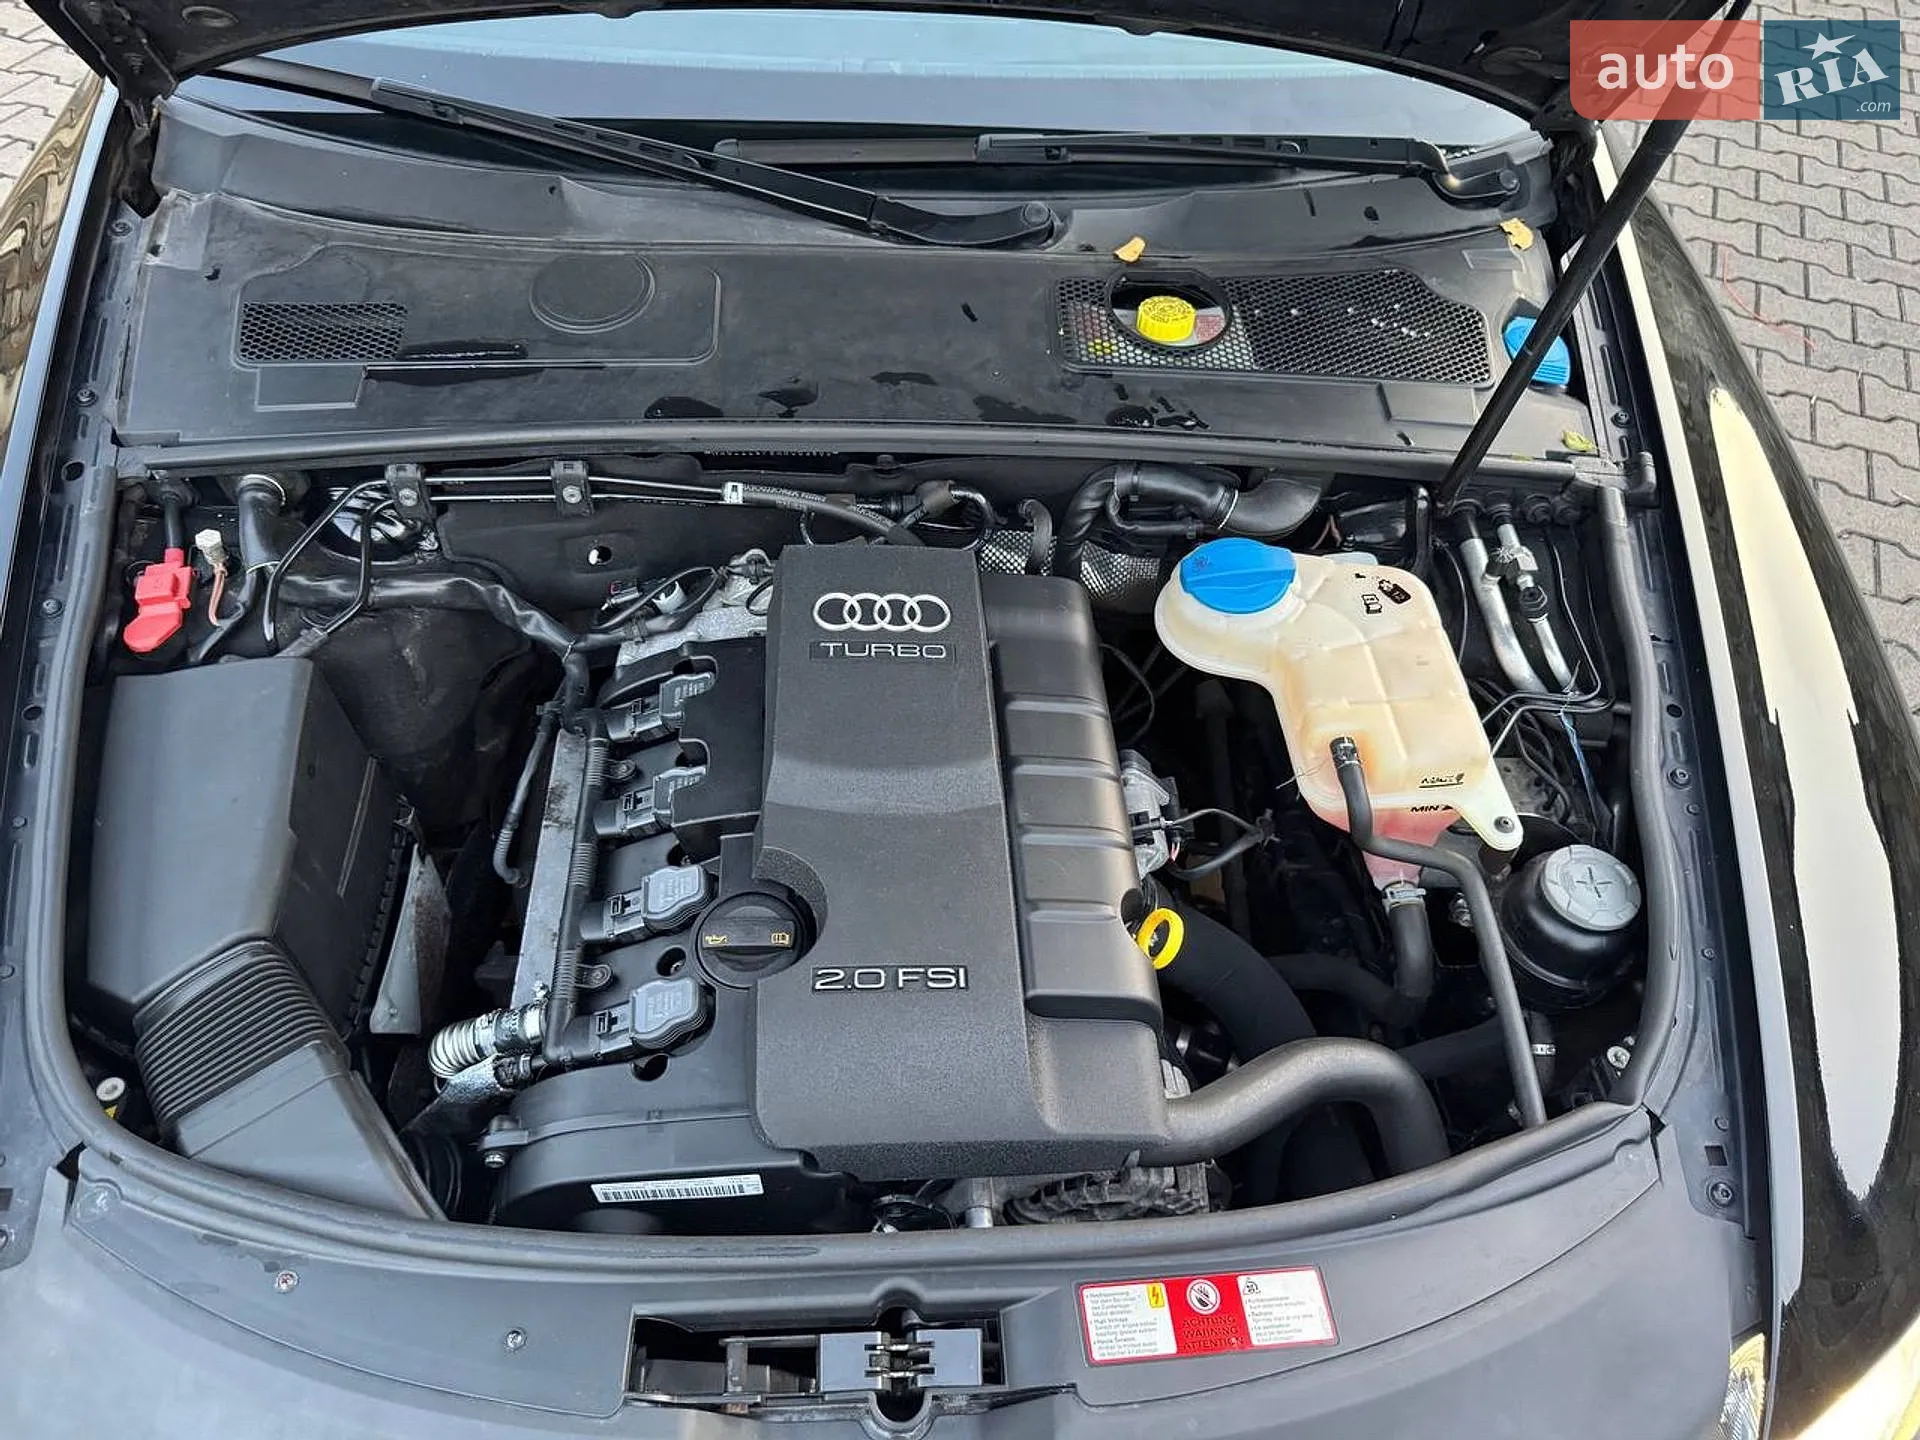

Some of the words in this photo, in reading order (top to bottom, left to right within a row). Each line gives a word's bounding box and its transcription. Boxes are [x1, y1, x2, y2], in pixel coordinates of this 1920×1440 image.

[819, 642, 947, 659] TURBO
[1410, 805, 1440, 813] MIN
[814, 968, 886, 990] 2.0
[898, 967, 966, 989] FSI
[1182, 1315, 1236, 1328] ACHTUNG
[1183, 1325, 1239, 1338] WARNING
[1183, 1336, 1244, 1350] ATTENTION
